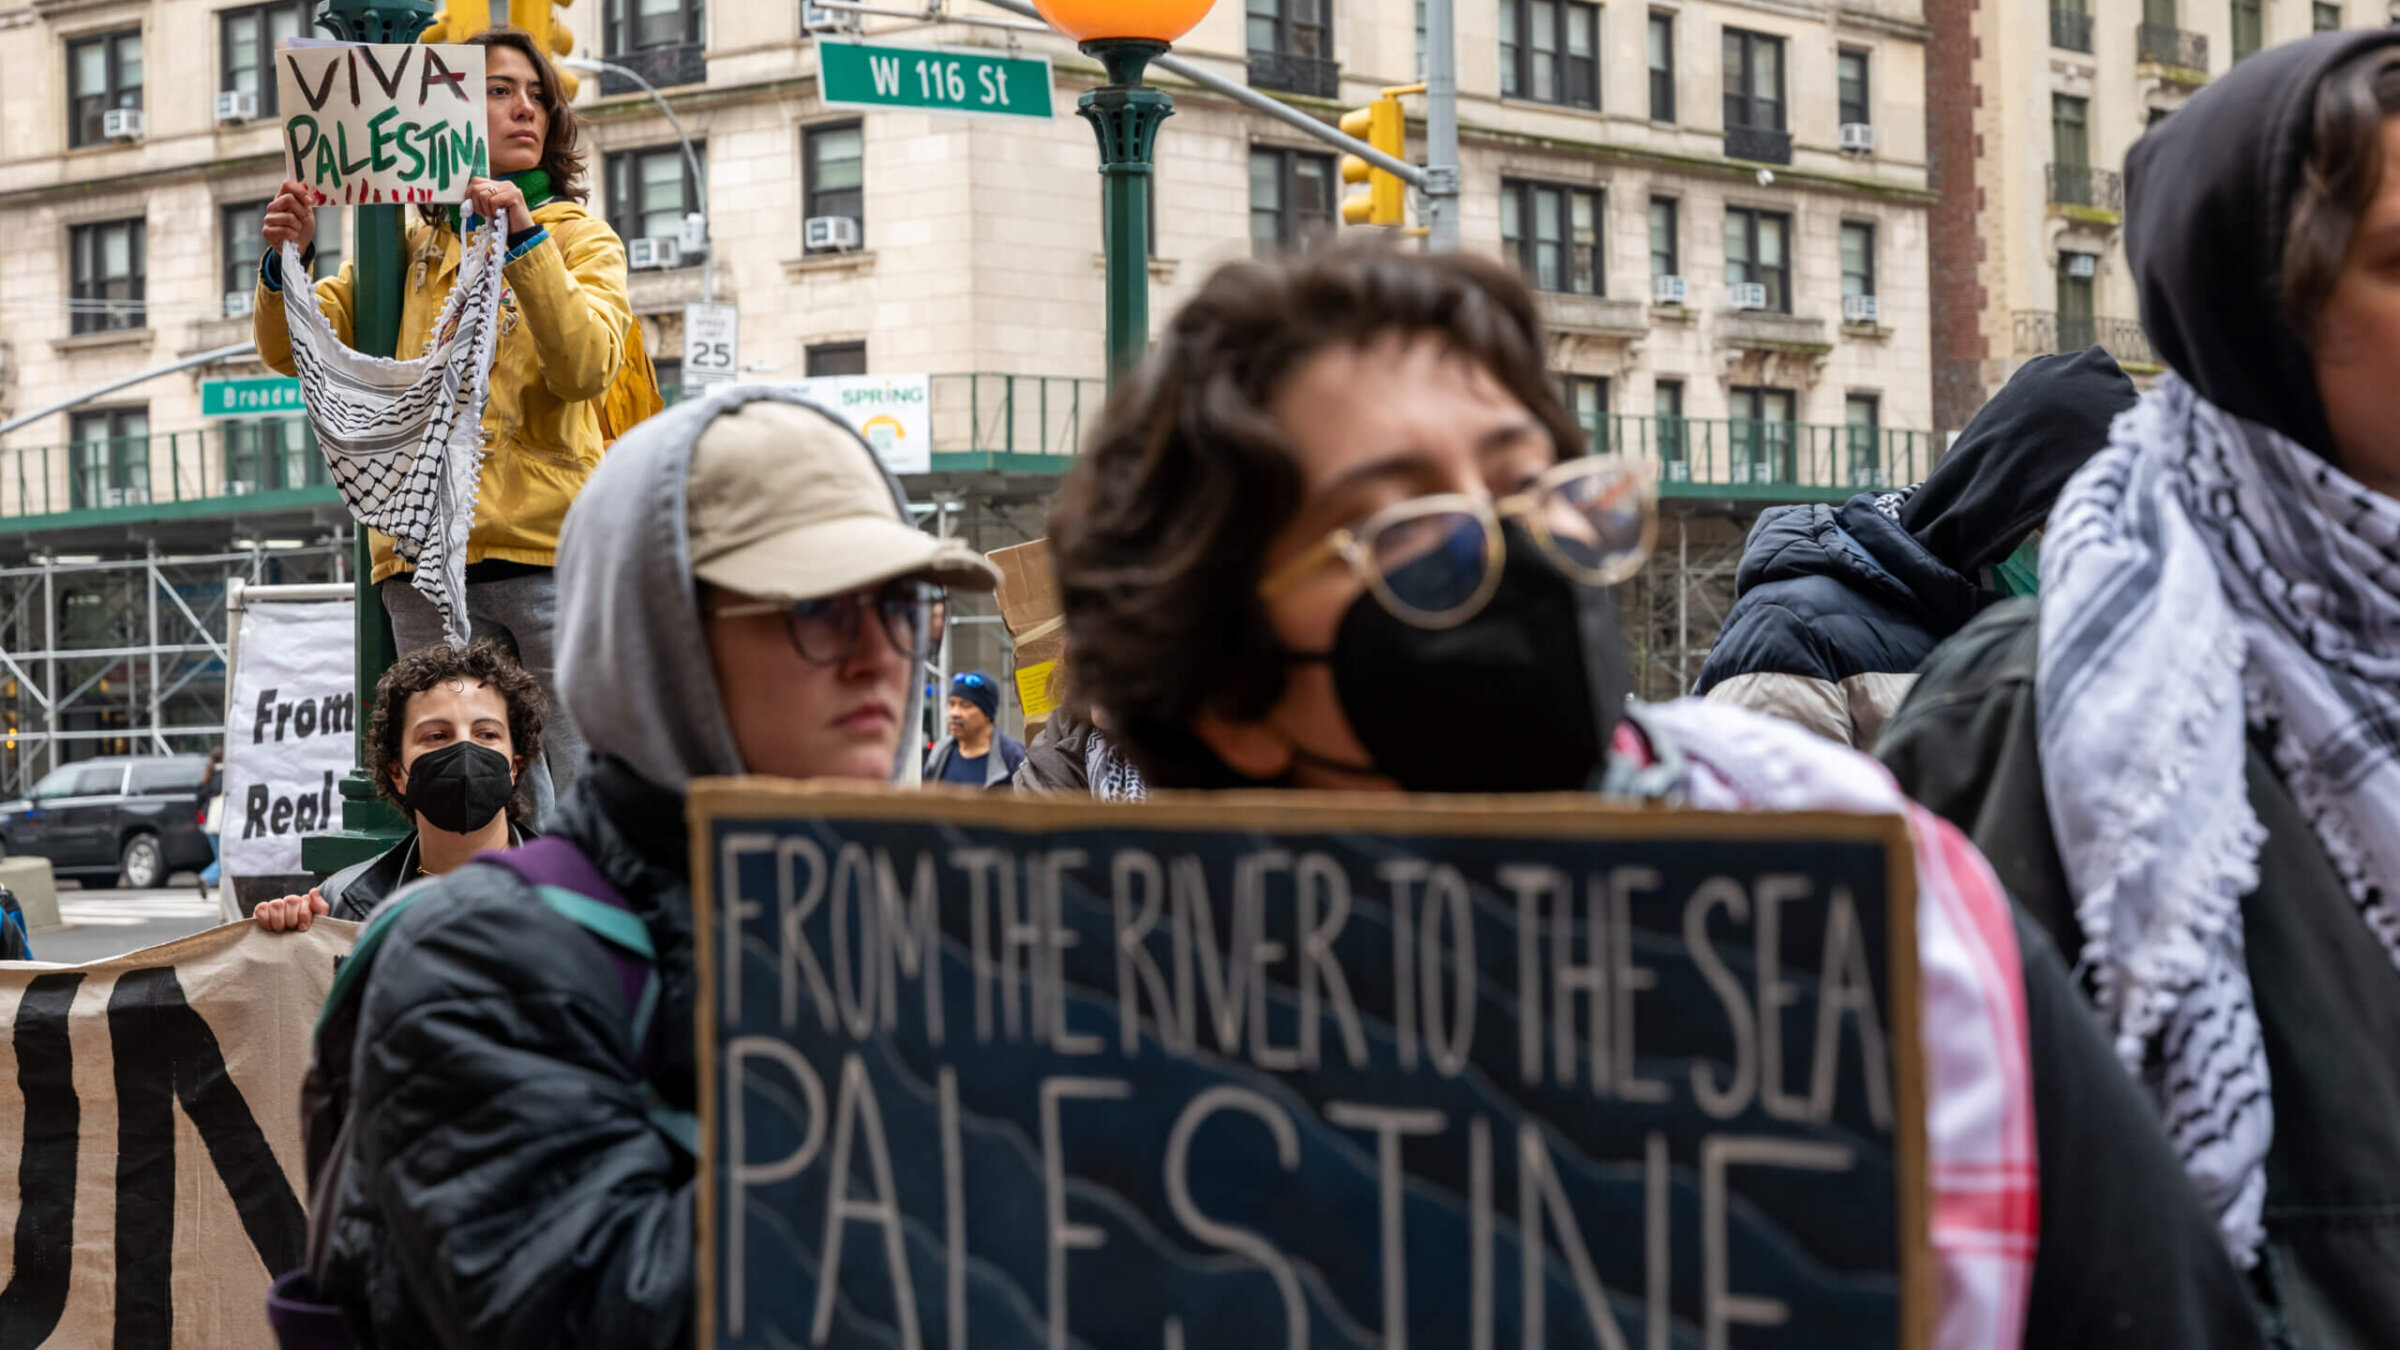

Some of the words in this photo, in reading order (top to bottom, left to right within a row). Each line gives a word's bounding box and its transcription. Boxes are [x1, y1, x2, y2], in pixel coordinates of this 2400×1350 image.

[286, 46, 469, 112] VIVA
[869, 55, 899, 97] W
[915, 59, 965, 102] 116
[978, 64, 1010, 106] St
[693, 341, 731, 367] 25
[253, 688, 355, 745] From
[242, 770, 334, 840] Real
[721, 832, 944, 1046] FROM
[949, 848, 1106, 1055] THE
[1110, 848, 1370, 1072] RIVER
[1375, 860, 1477, 1078] TO
[1498, 865, 1672, 1102] THE
[1683, 874, 1896, 1133] SEA
